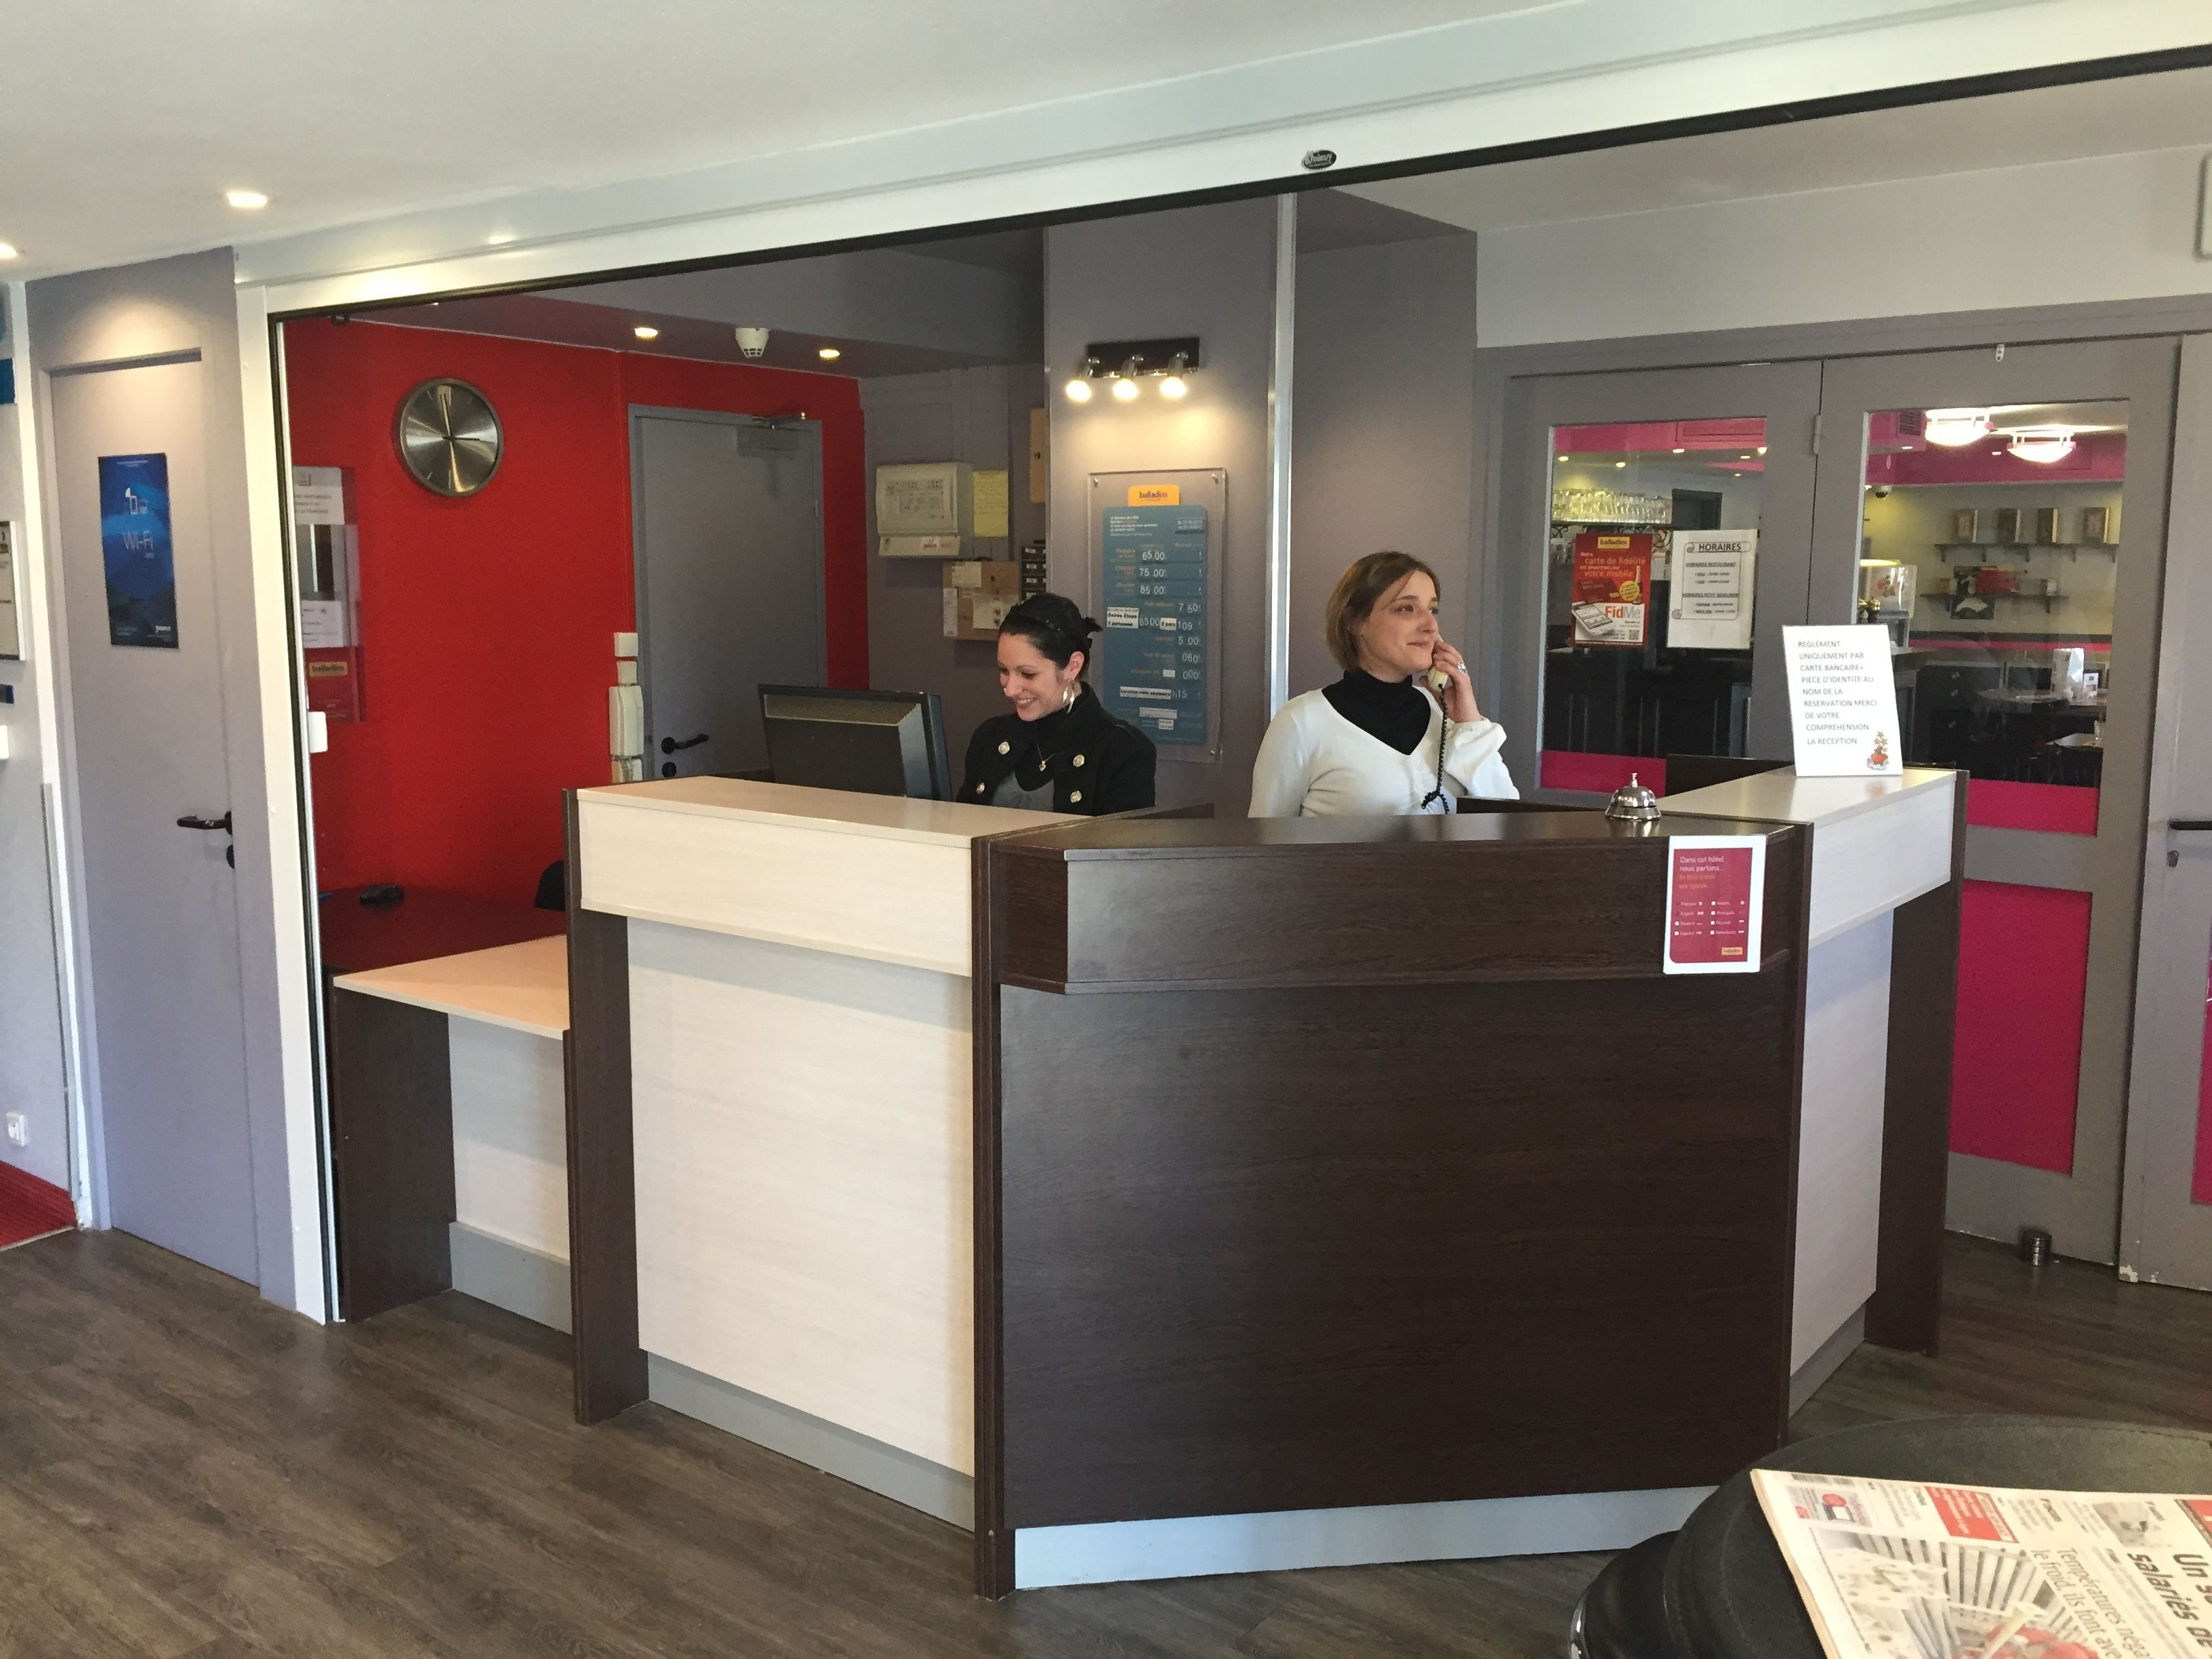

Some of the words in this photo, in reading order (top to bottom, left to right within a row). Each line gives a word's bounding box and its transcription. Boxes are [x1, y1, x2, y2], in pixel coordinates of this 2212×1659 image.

[1605, 605, 1641, 619] FidMe
[2030, 1549, 2050, 1559] le
[2062, 1593, 2086, 1607] ils
[2074, 1609, 2106, 1635] font
[2057, 1547, 2127, 1624] Températures
[2127, 1553, 2200, 1620] salariés
[2173, 1553, 2209, 1578] Un
